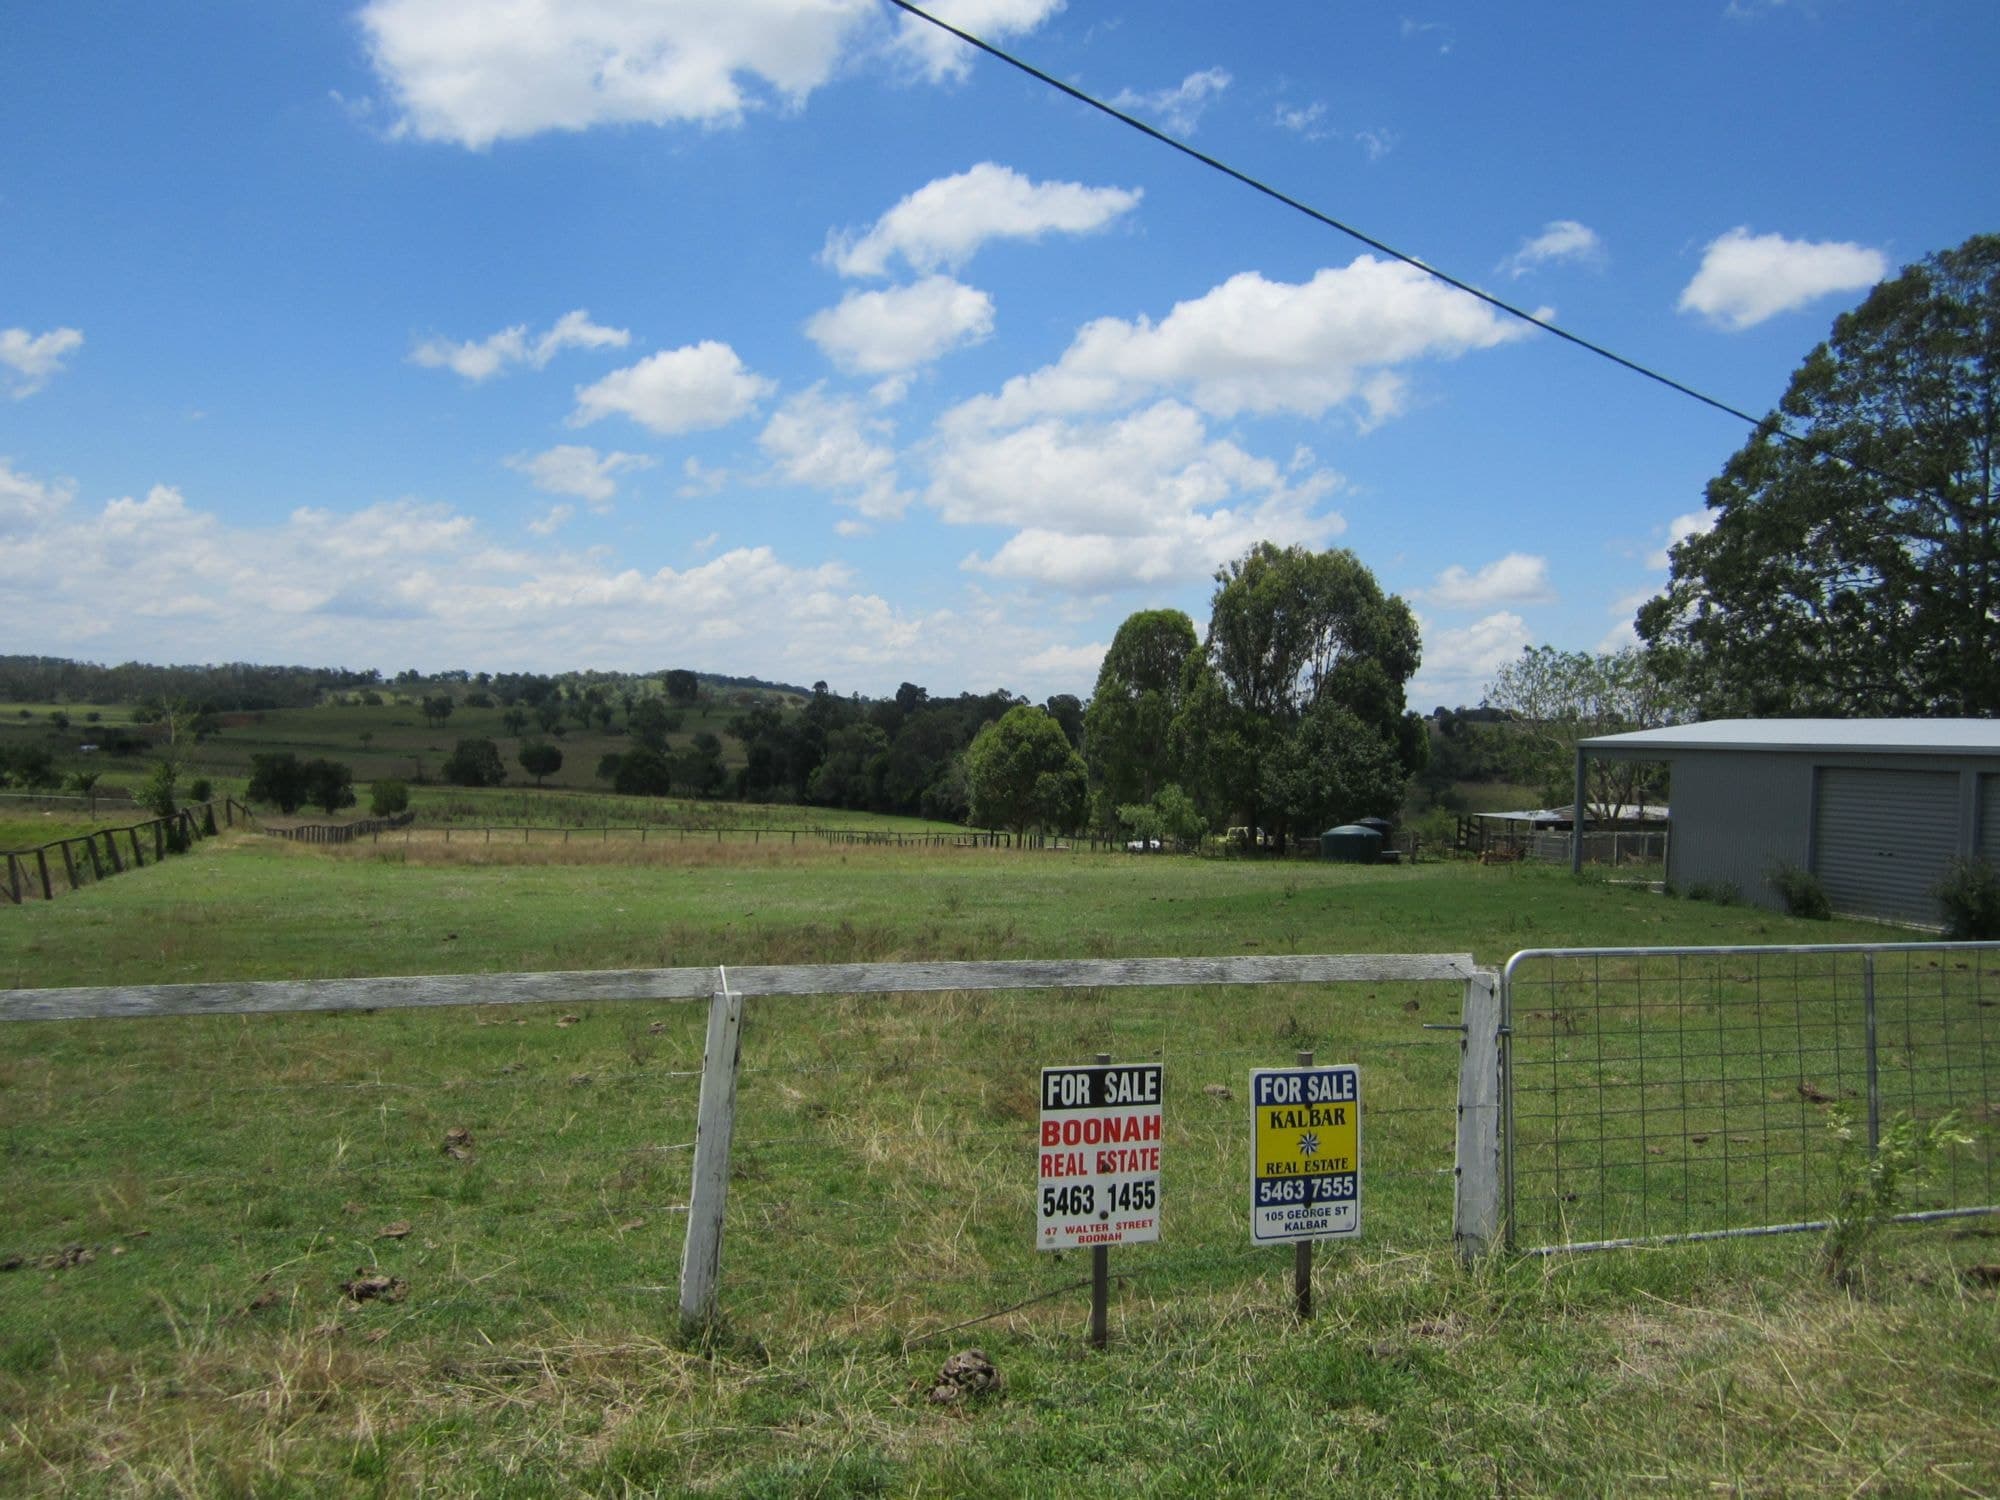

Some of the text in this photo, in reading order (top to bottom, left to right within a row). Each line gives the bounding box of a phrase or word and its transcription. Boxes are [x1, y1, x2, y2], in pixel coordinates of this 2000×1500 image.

[1047, 1071, 1156, 1106] FOR SALE
[1260, 1073, 1354, 1103] FOR SALE
[1270, 1108, 1346, 1129] KALBAR
[1041, 1114, 1161, 1147] BOONAH
[1041, 1147, 1159, 1177] REAL ESTATE
[1266, 1157, 1349, 1175] REAL ESTATE
[1043, 1180, 1156, 1217] 5463 1455
[1260, 1176, 1354, 1202] 5463 7555
[1265, 1206, 1349, 1221] 105 GEORGE ST
[1044, 1219, 1153, 1236] 47 WALTER STREET
[1284, 1219, 1328, 1232] KALBAR
[1078, 1232, 1122, 1244] BOONAH
